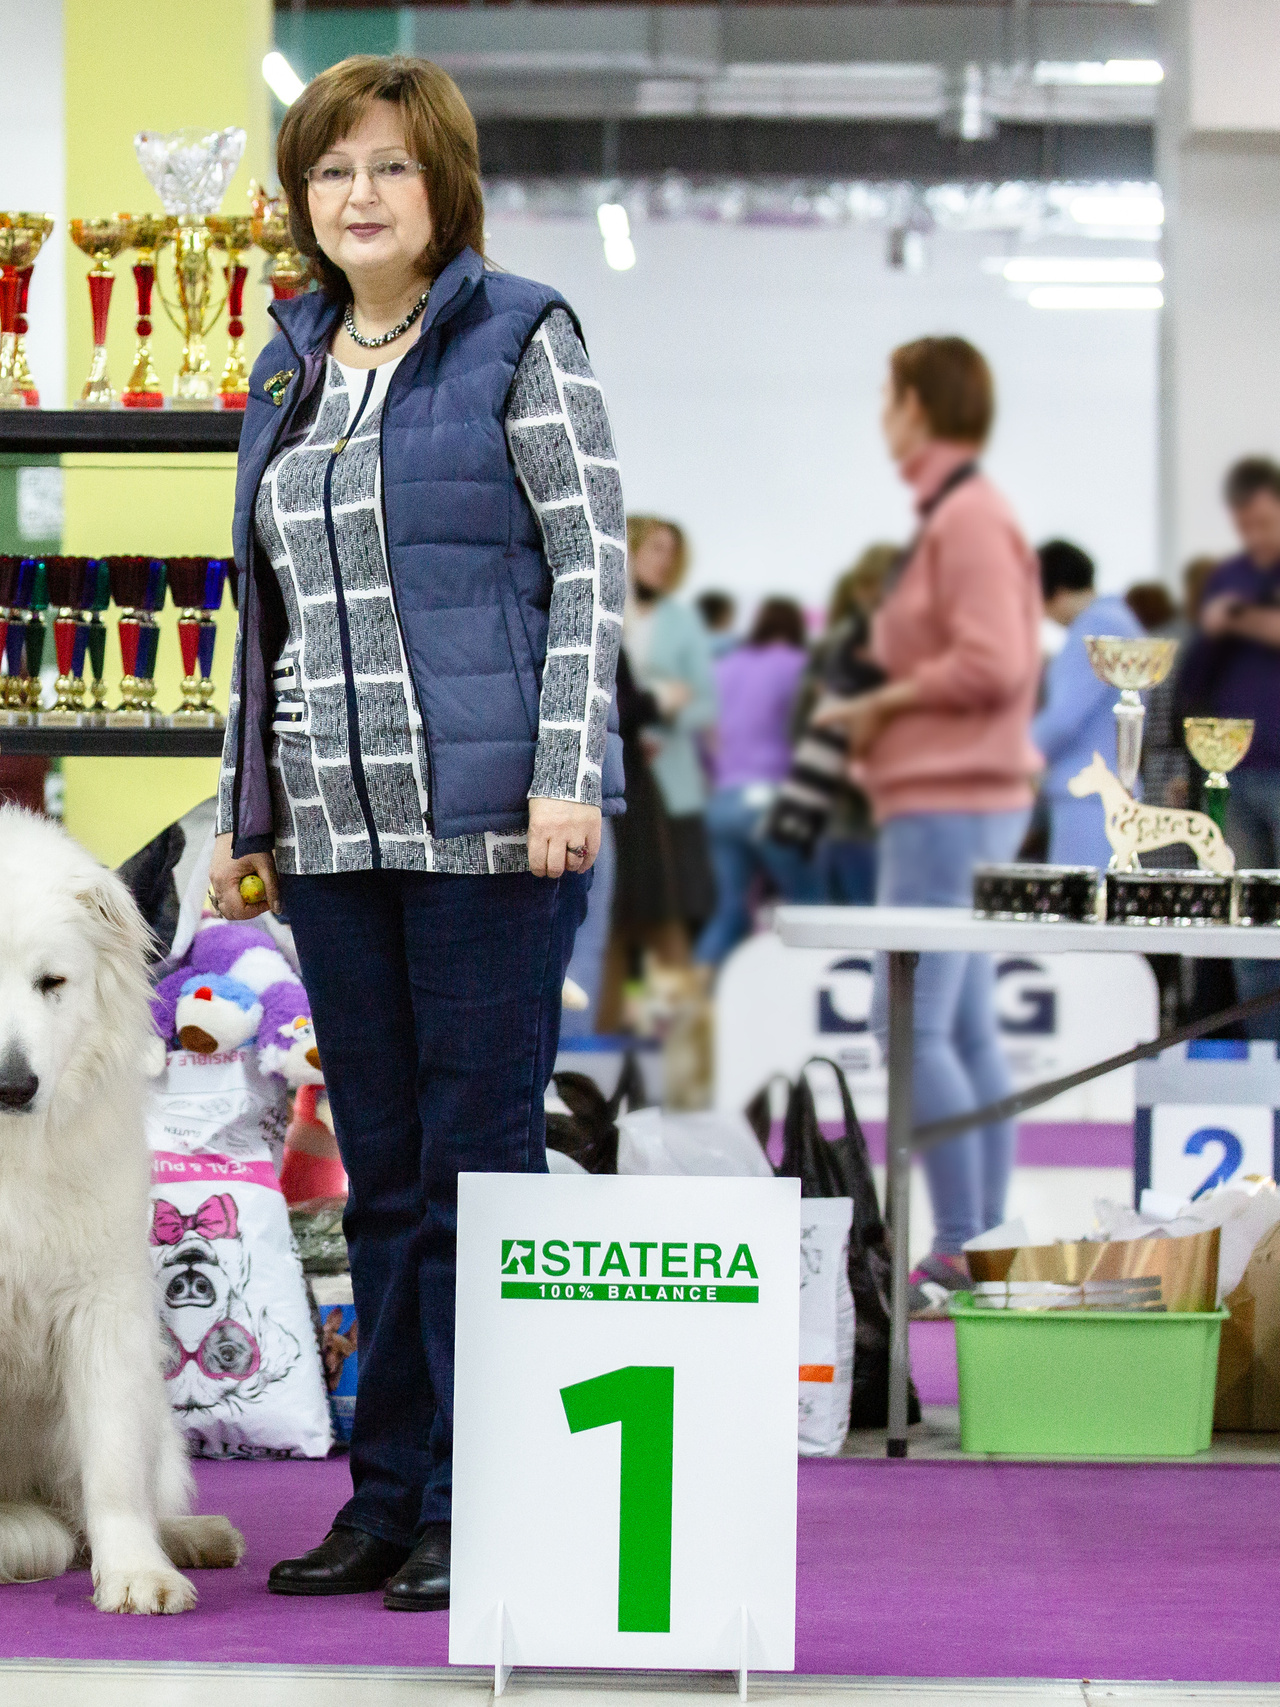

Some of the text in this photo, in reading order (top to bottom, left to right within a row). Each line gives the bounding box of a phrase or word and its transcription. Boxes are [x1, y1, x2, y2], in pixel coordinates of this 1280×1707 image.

[541, 1239, 759, 1279] STATERA
[538, 1284, 718, 1301] 100% BALANCE
[560, 1366, 674, 1633] 1
